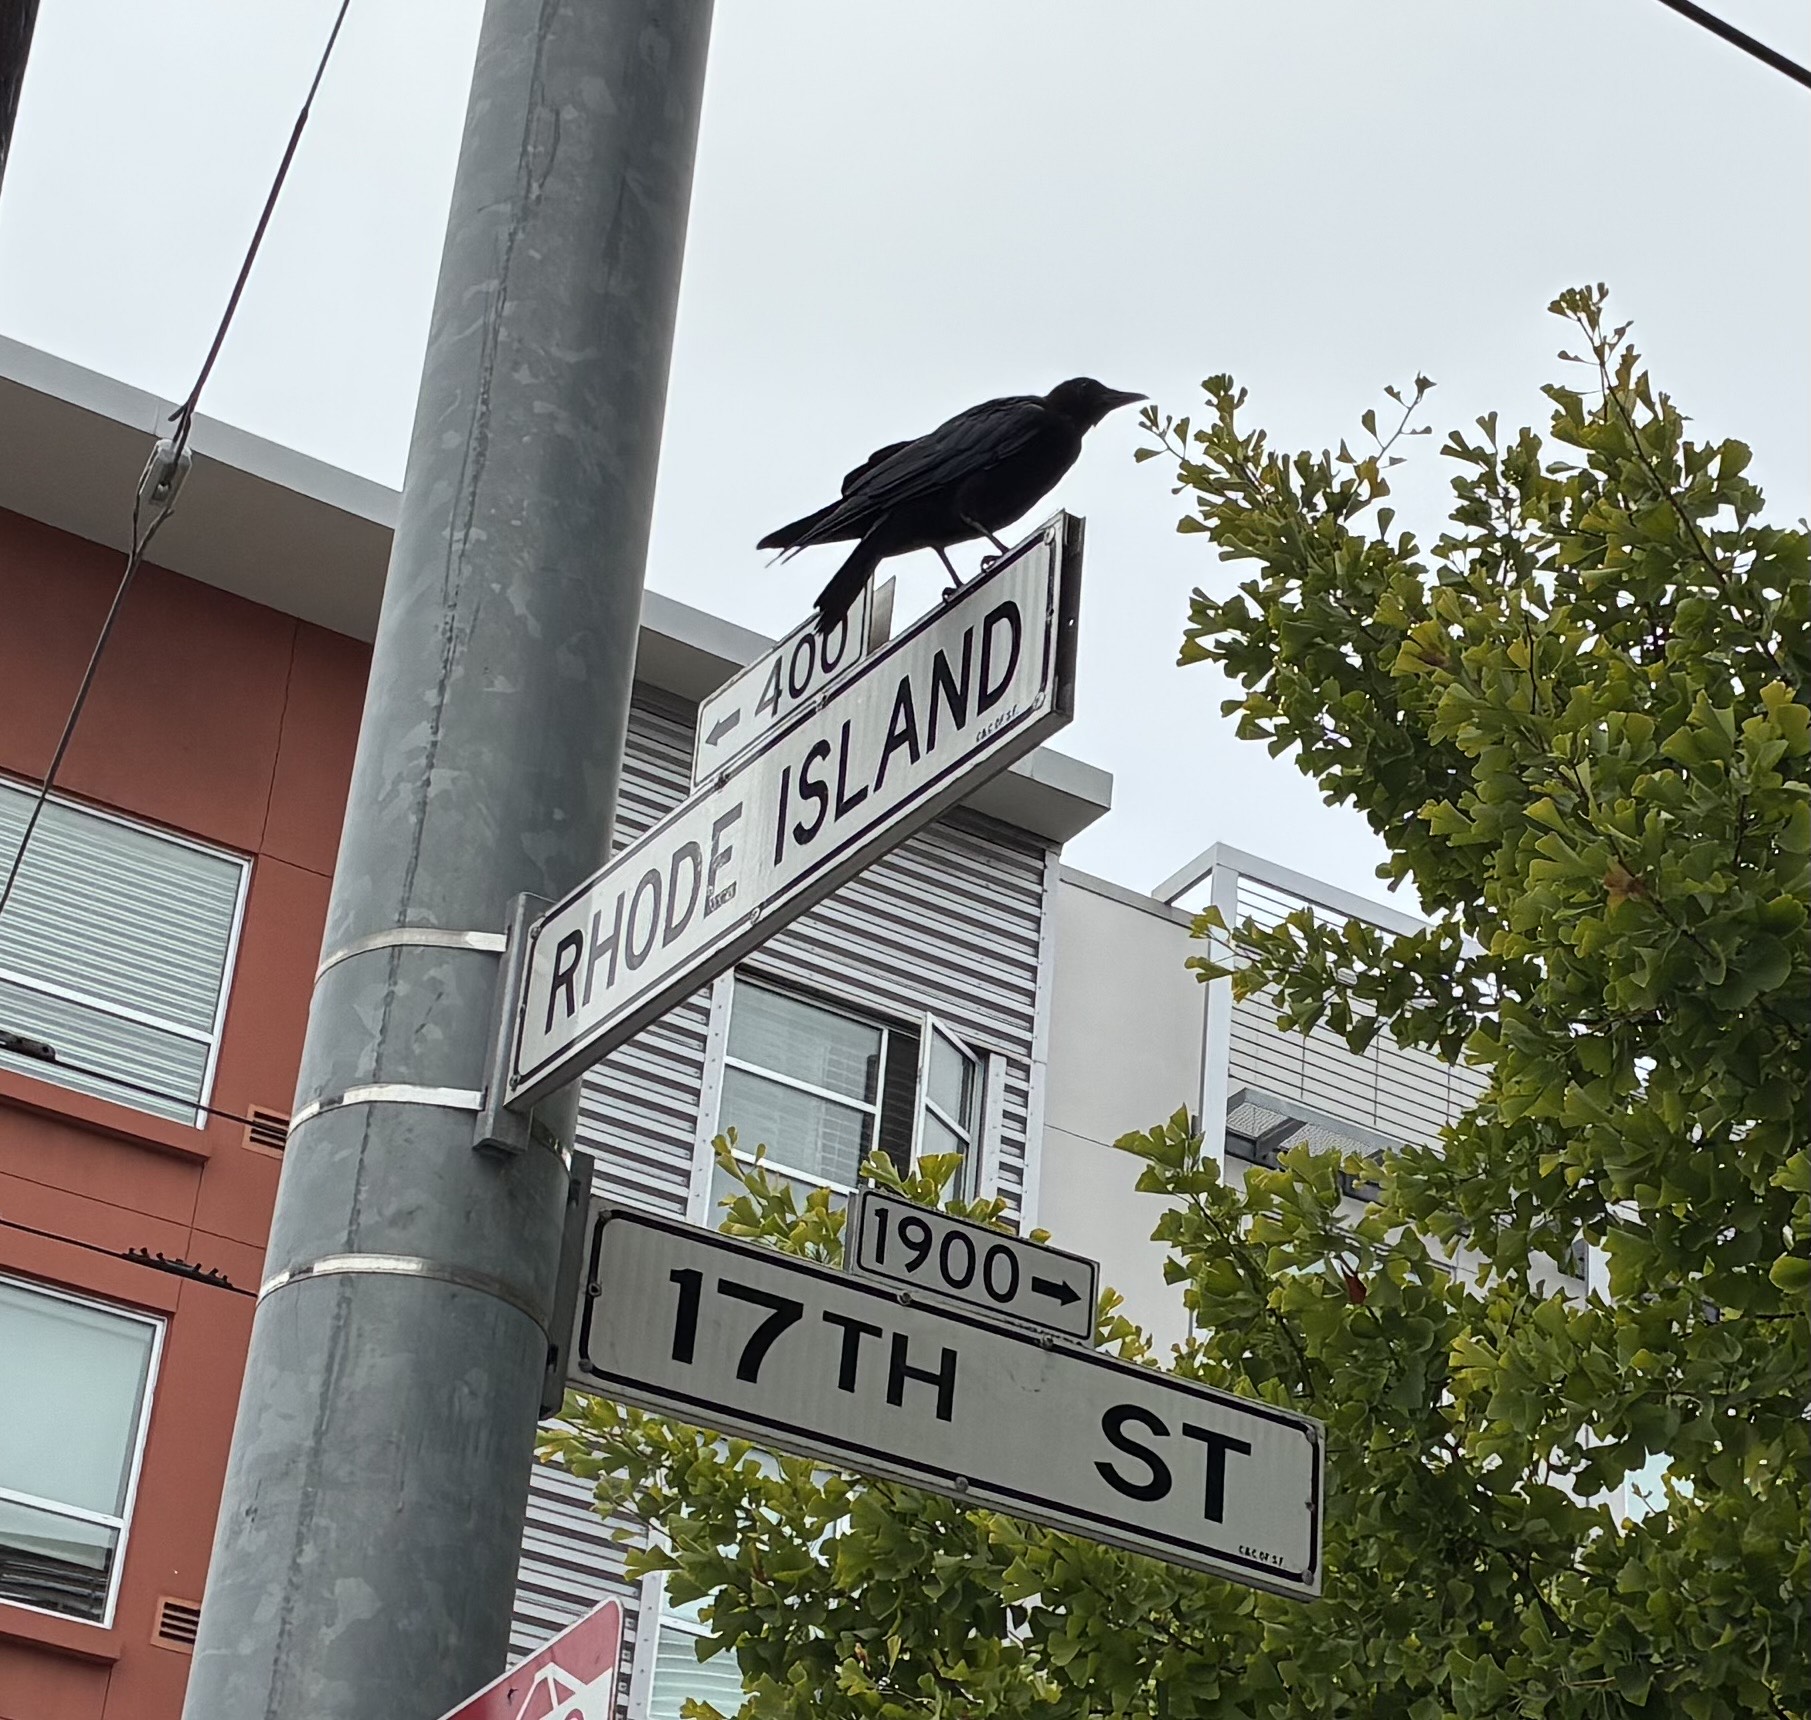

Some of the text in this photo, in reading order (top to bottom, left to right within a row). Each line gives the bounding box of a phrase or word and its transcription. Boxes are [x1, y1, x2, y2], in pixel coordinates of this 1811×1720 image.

[754, 611, 849, 718] 400
[544, 600, 1022, 1035] RHODE ISLAND
[873, 1207, 1020, 1304] 1900
[668, 1267, 1253, 1525] 17TH ST
